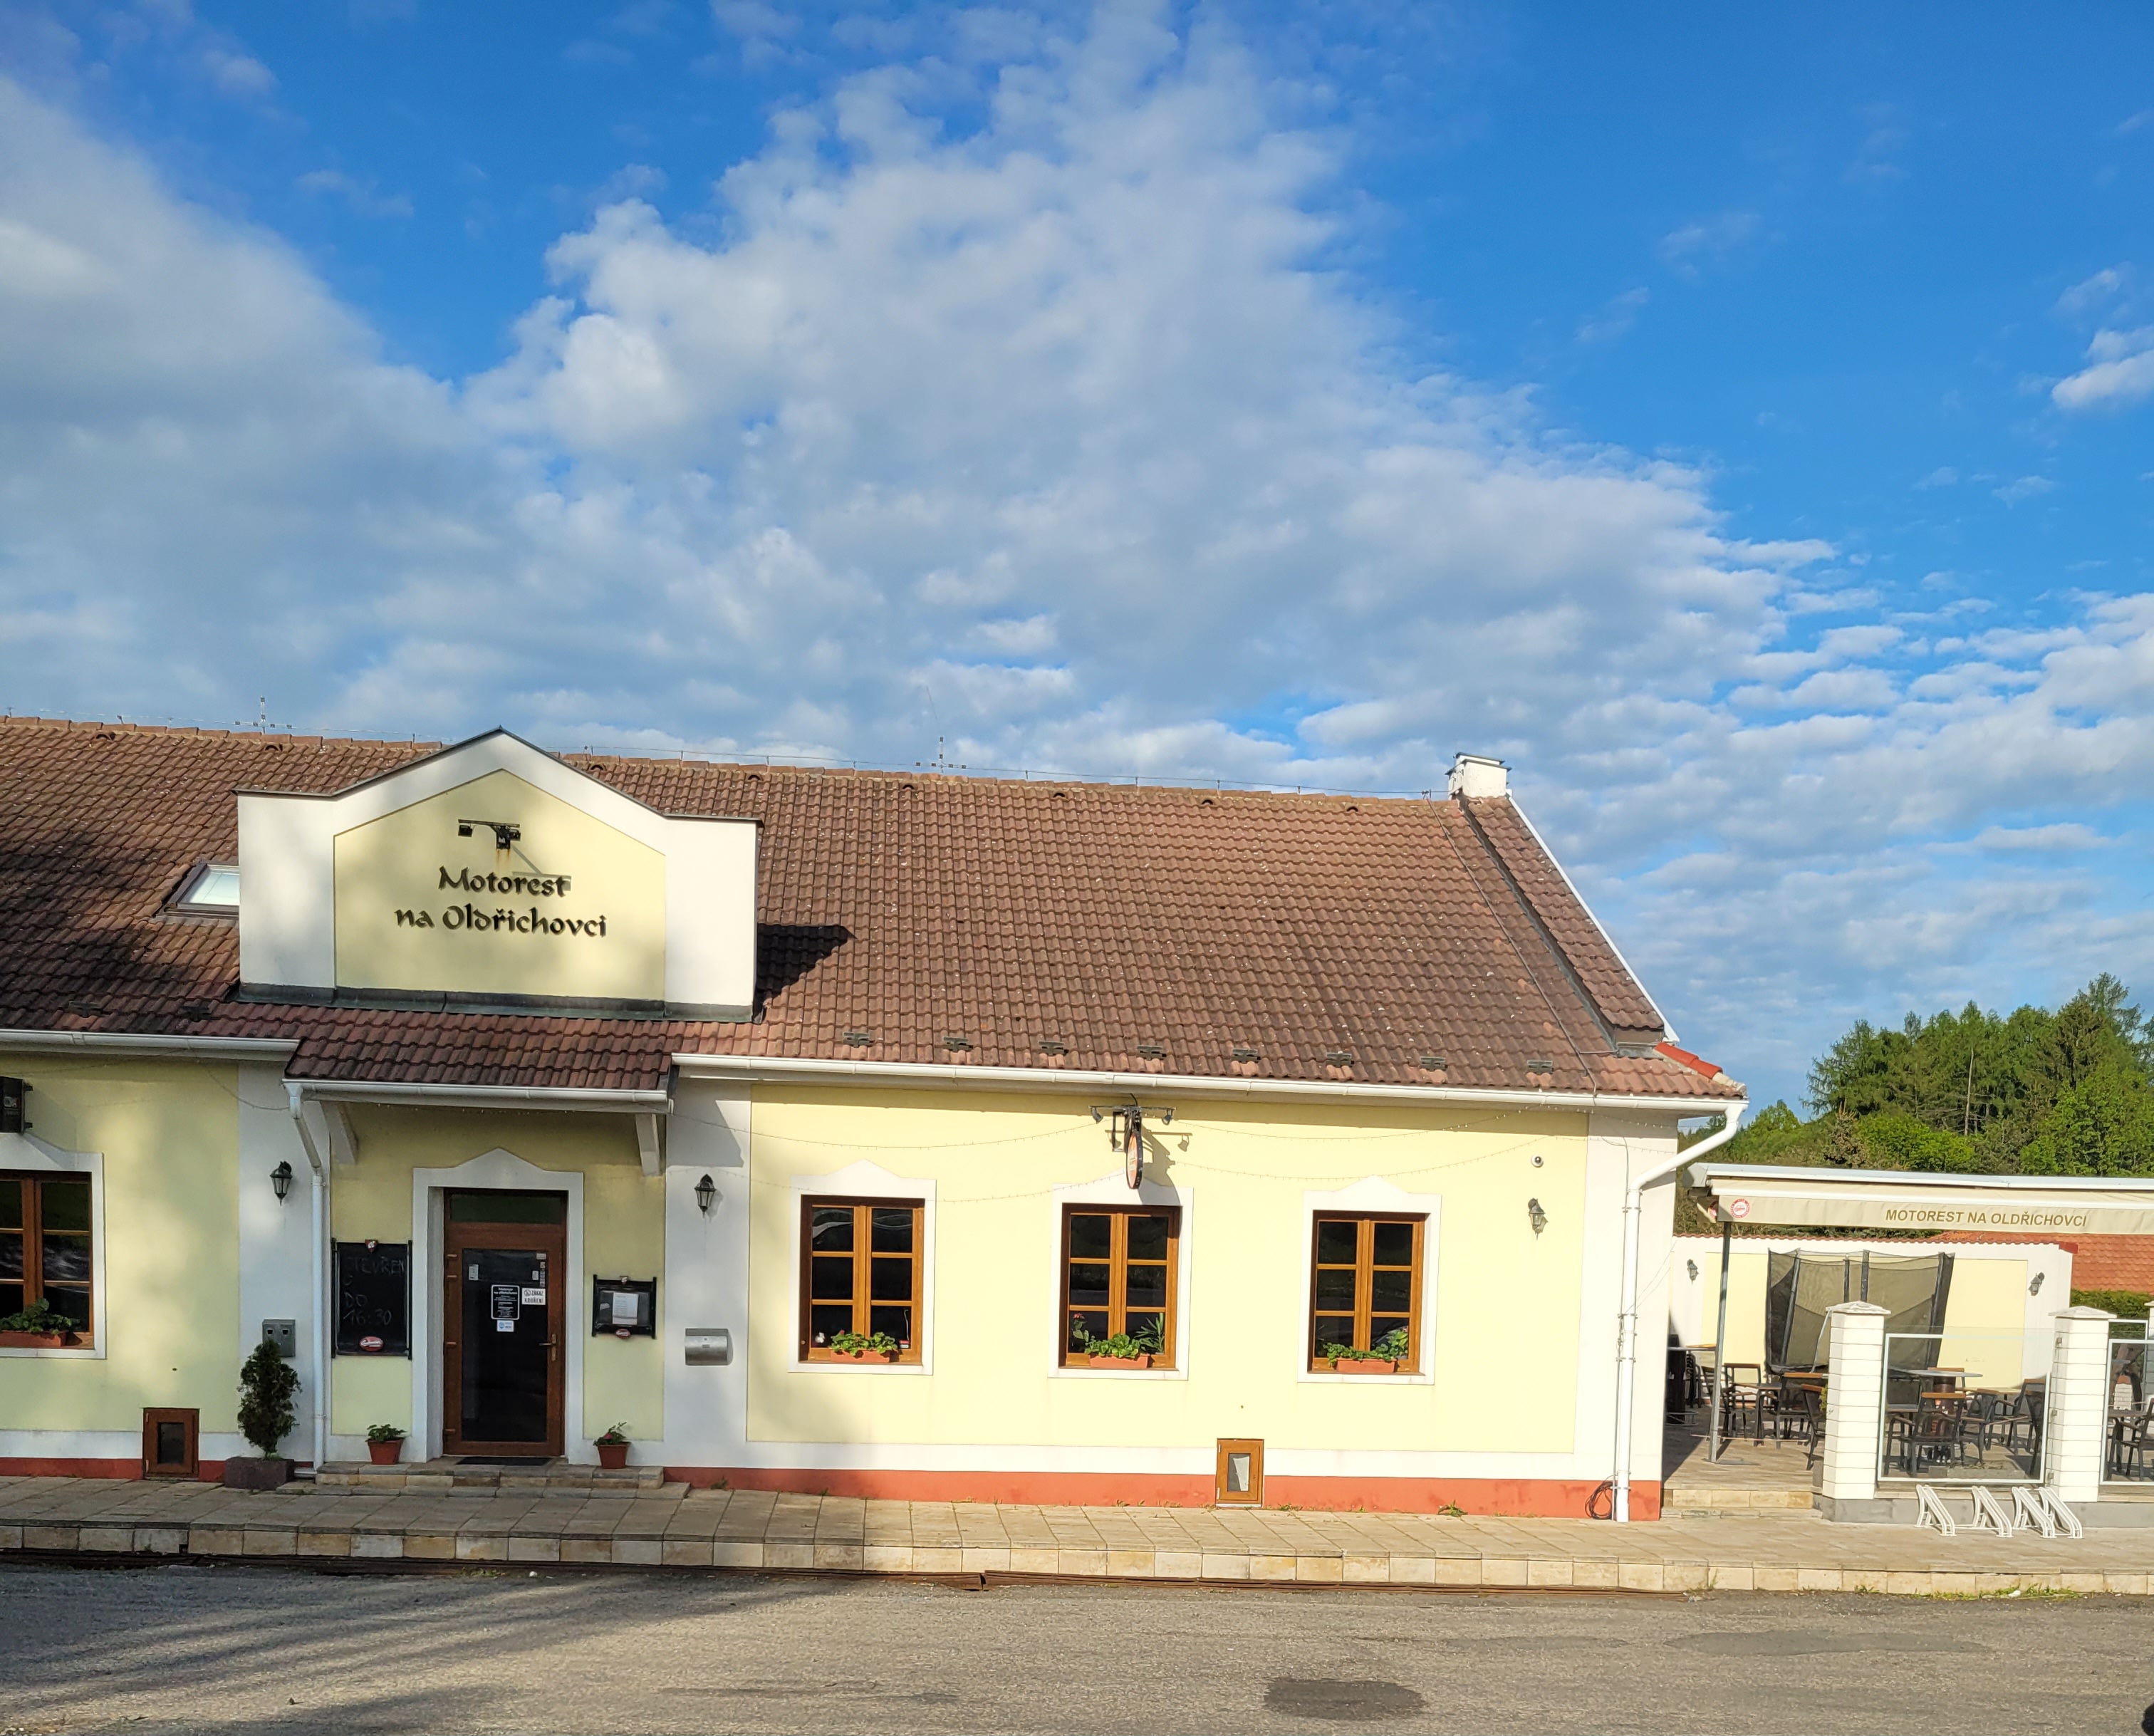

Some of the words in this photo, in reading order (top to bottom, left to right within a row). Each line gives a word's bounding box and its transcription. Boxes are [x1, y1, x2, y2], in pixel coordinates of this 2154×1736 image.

[438, 866, 566, 897] Motorest
[394, 908, 435, 928] na
[442, 903, 607, 937] Oldřichovci
[1885, 1210, 1964, 1222] MOTOREST
[1967, 1212, 1986, 1224] NA
[1991, 1212, 2086, 1227] OLDŘICHOVCI
